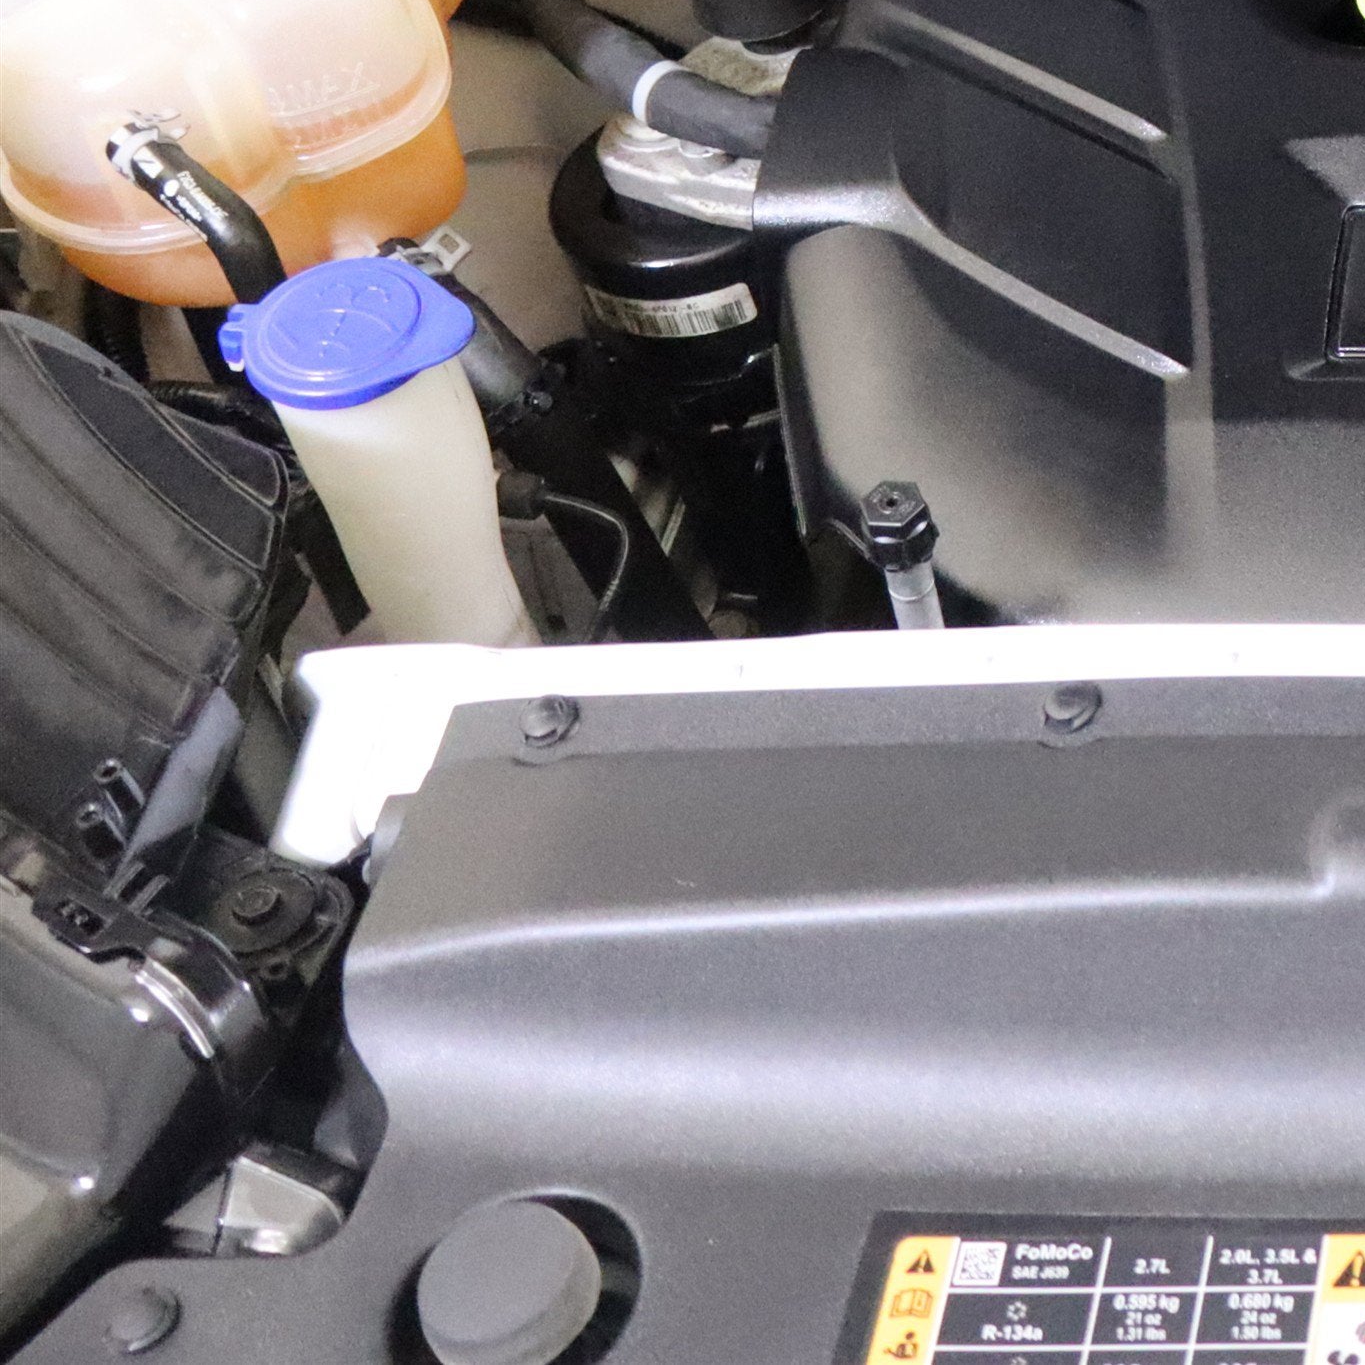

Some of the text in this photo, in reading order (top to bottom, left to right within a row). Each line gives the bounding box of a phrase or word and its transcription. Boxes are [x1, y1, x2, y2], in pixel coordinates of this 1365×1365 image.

[1014, 1243, 1094, 1261] FoMoCo
[1263, 1248, 1300, 1264] 3.5L
[1302, 1248, 1317, 1264] &
[1012, 1265, 1039, 1280] SAE
[1133, 1258, 1171, 1275] 2.7L
[1247, 1269, 1284, 1285] 3.7L
[1158, 1294, 1181, 1314] kg
[1272, 1293, 1295, 1313] kg
[1125, 1311, 1163, 1326] 21 oz
[1258, 1312, 1277, 1325] oz
[980, 1324, 1044, 1341] R-134a
